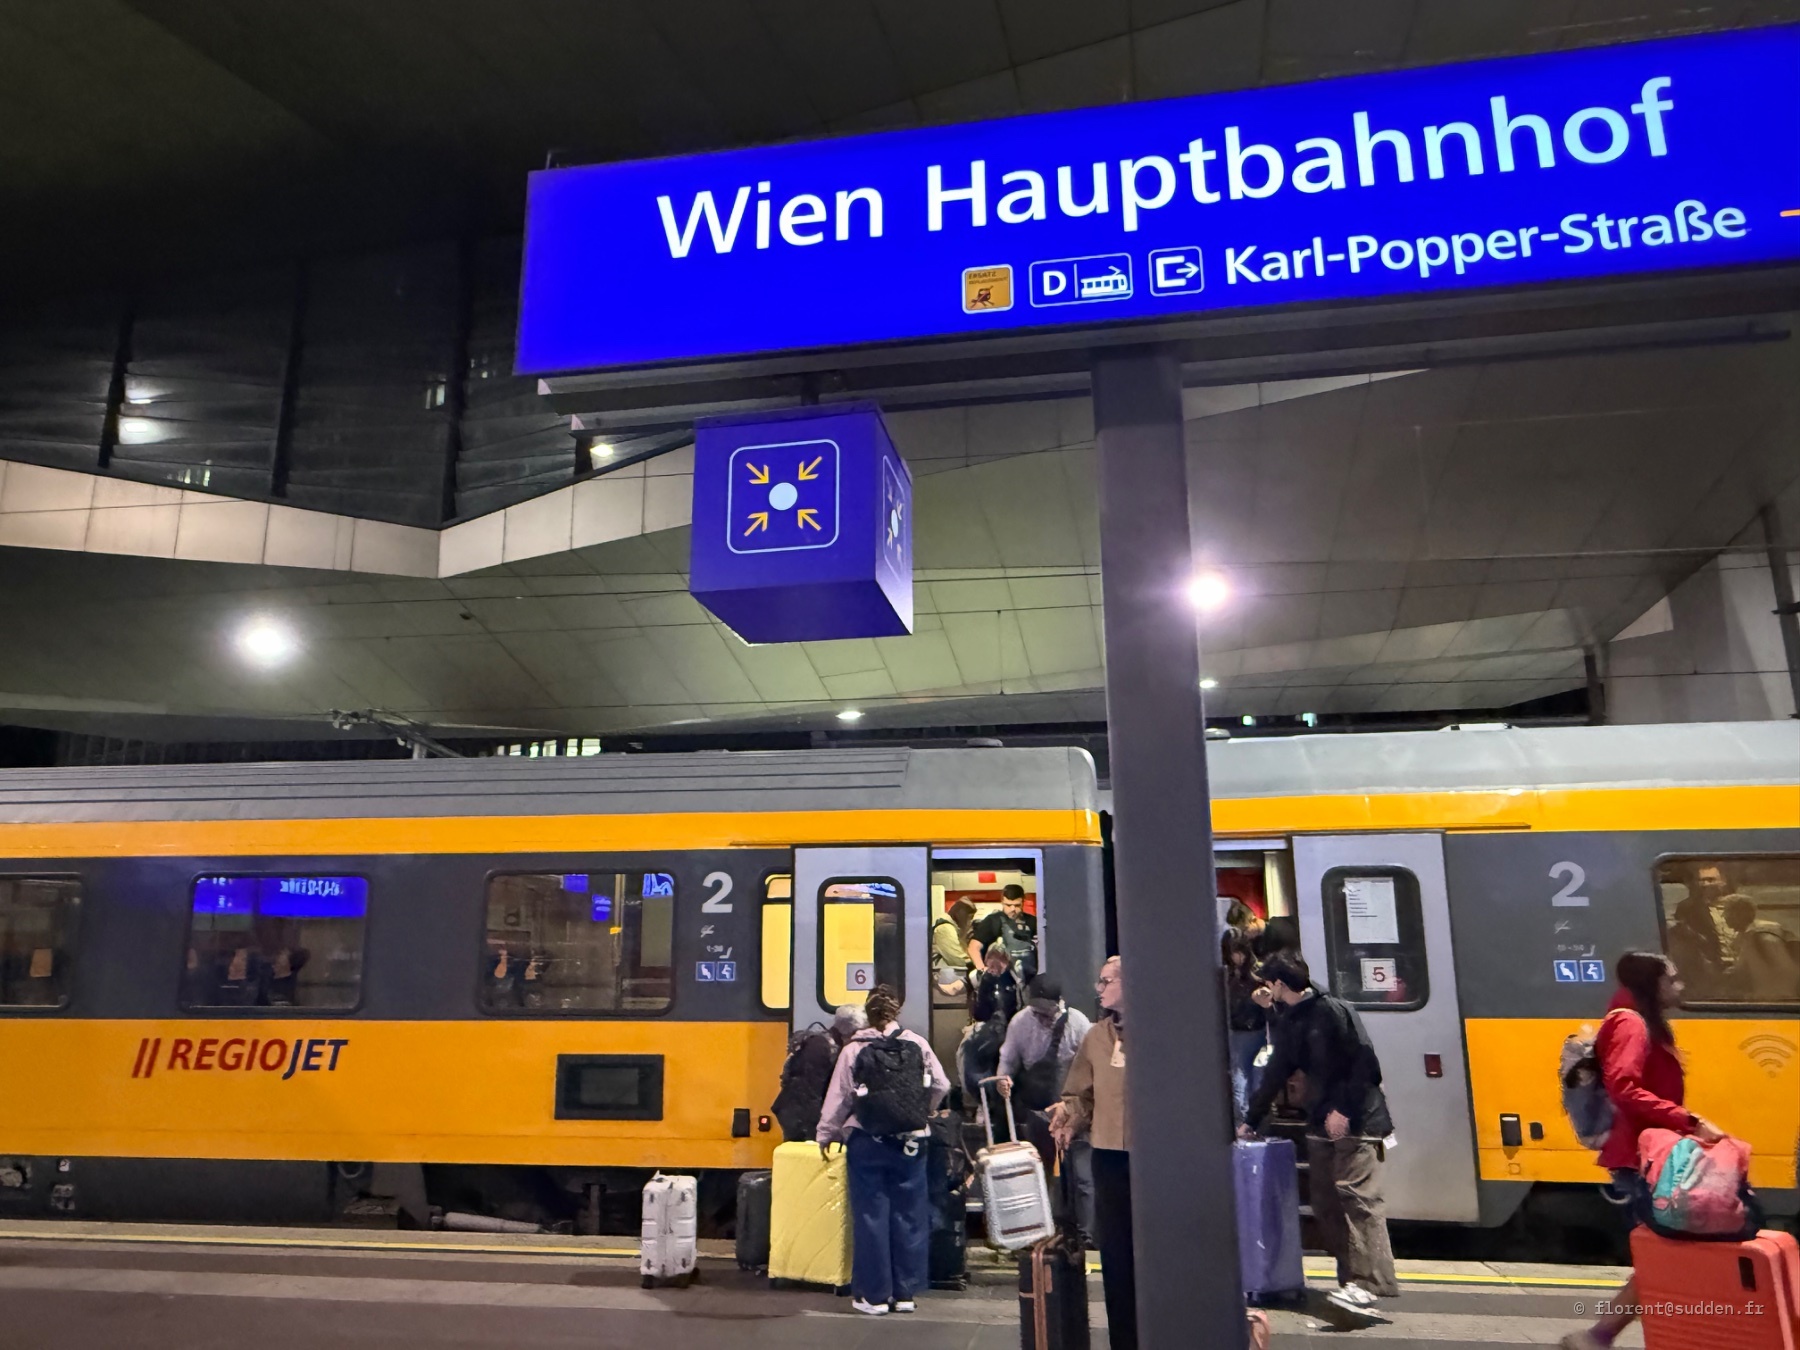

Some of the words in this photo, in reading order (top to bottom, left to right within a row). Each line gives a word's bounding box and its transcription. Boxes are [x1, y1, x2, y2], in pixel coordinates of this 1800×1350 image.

[656, 181, 883, 259] Wien
[926, 76, 1674, 232] Hauptbahnhof
[1225, 199, 1748, 285] Karl-Popper-Straße
[1043, 270, 1067, 296] D
[701, 871, 733, 913] 2
[1548, 861, 1590, 907] 2
[854, 968, 867, 985] 6
[1372, 966, 1386, 982] 5
[167, 1038, 349, 1080] REGIOJET
